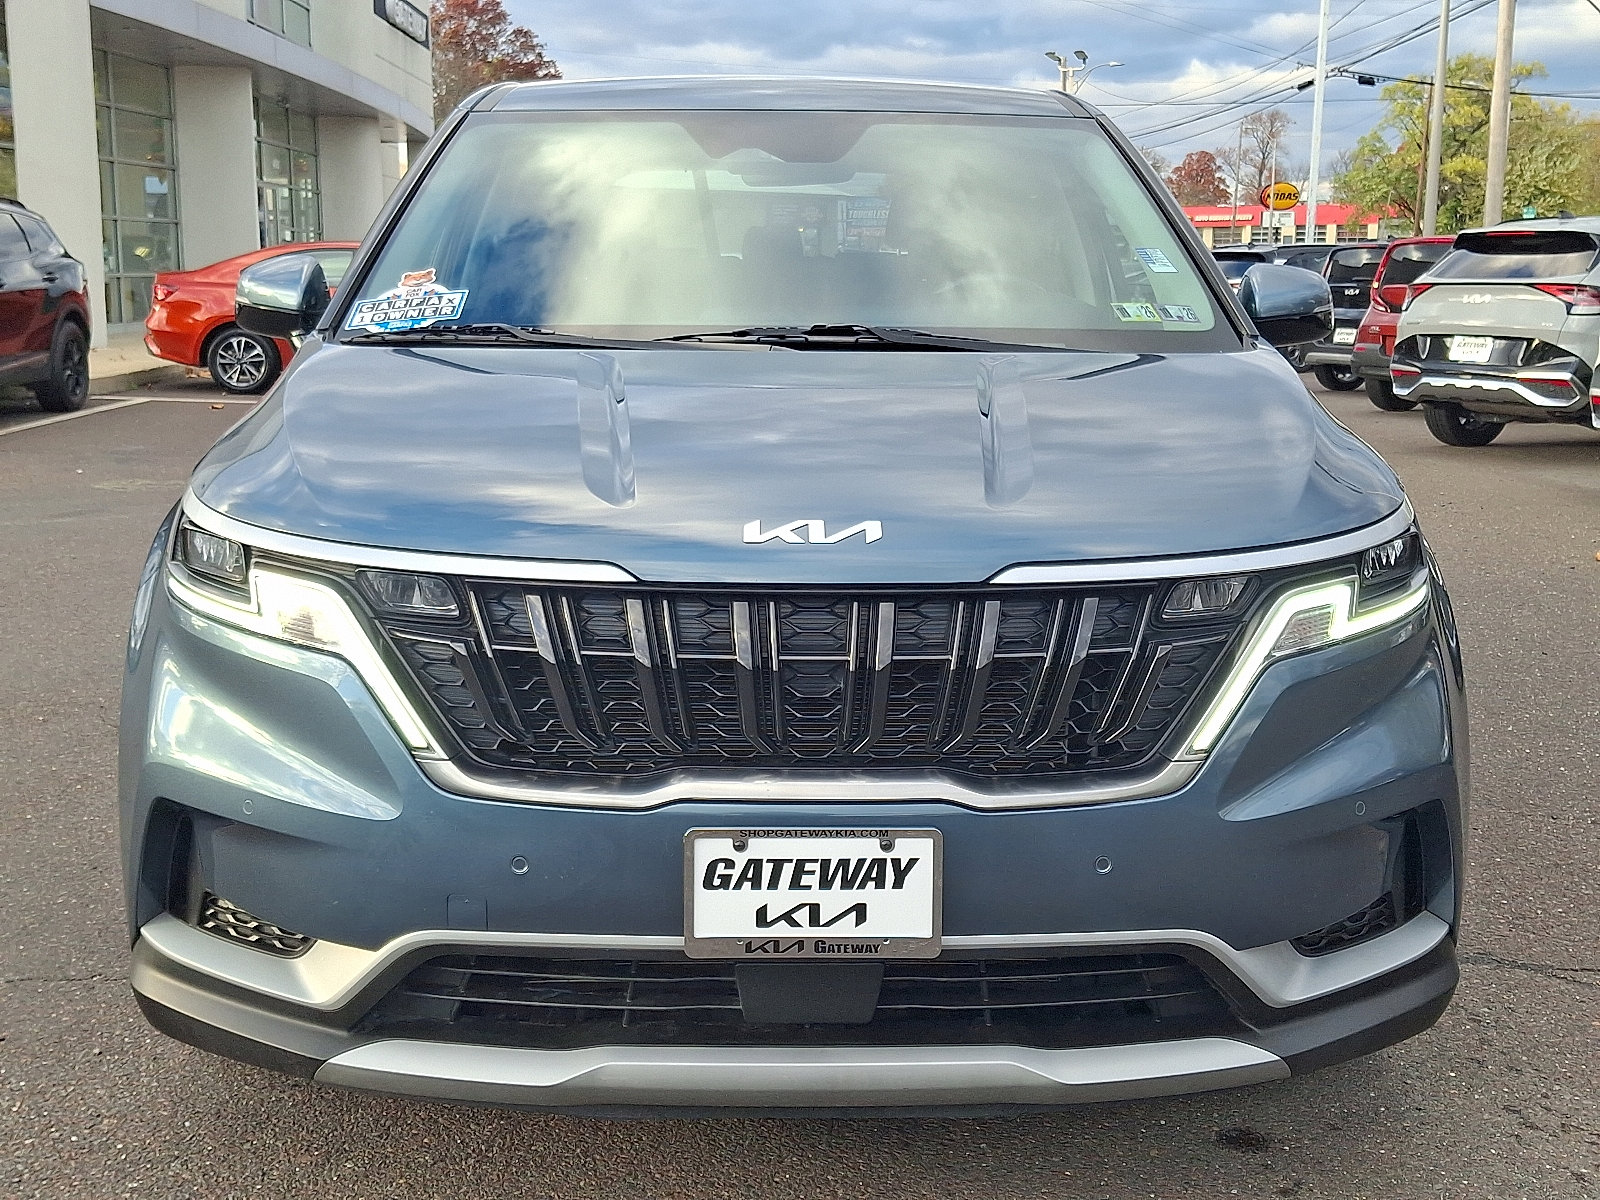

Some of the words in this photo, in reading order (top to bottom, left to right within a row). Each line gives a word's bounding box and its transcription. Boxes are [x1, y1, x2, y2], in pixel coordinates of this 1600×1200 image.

[360, 297, 456, 314] CARFAX
[1141, 305, 1156, 318] 26
[371, 306, 456, 322] OWNER
[742, 519, 883, 545] KIA
[739, 829, 889, 838] SHOPGATEWAYKIA.COM
[702, 857, 920, 891] GATEWAY
[755, 902, 868, 929] KIA
[744, 939, 805, 954] KIA
[813, 939, 882, 954] GATEWAY
